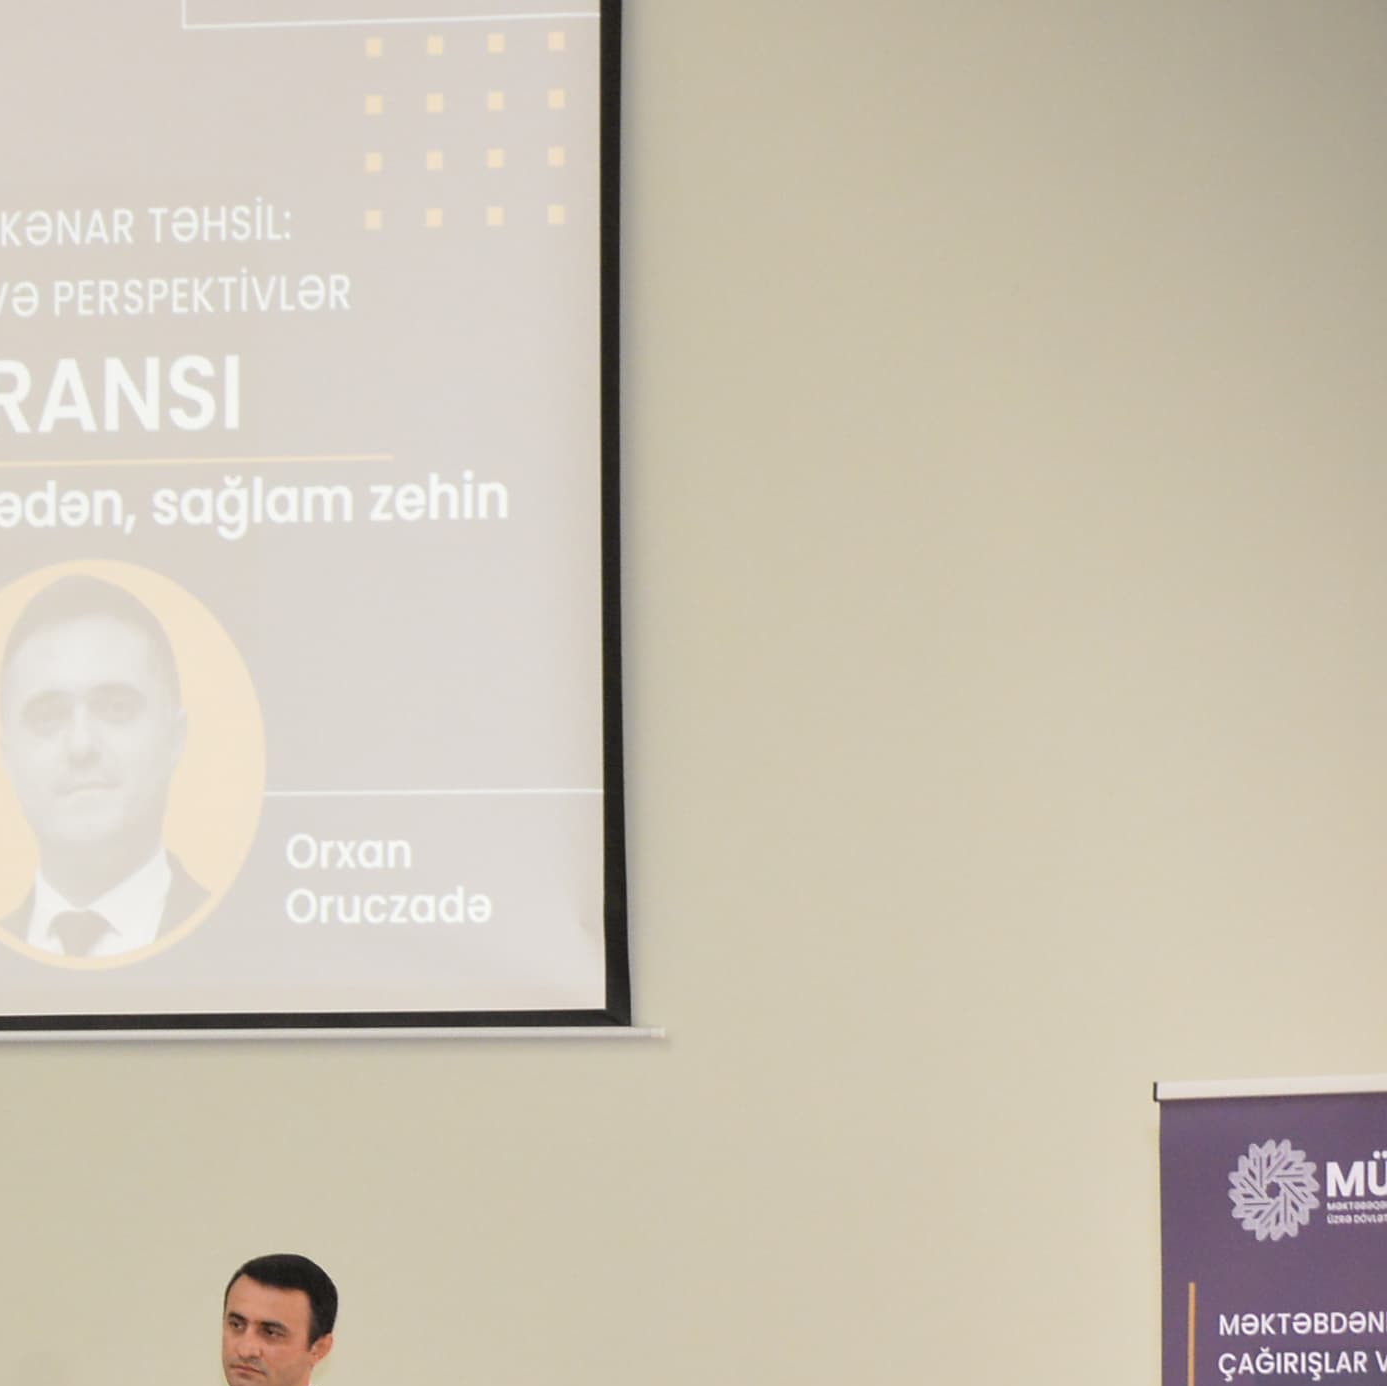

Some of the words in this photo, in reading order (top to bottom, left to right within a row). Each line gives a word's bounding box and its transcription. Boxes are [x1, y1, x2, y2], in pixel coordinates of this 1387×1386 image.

[148, 196, 292, 244] TƏHSİL:
[53, 267, 351, 317] PERSPEKTİVLƏR
[151, 474, 353, 540] sağlam
[370, 470, 508, 523] zehin
[286, 833, 412, 869] Orxan
[285, 884, 492, 924] Oruczadə
[1219, 1311, 1387, 1336] MƏKTƏBDƏN
[1218, 1347, 1368, 1382] ÇAĞIRIŞLAR
